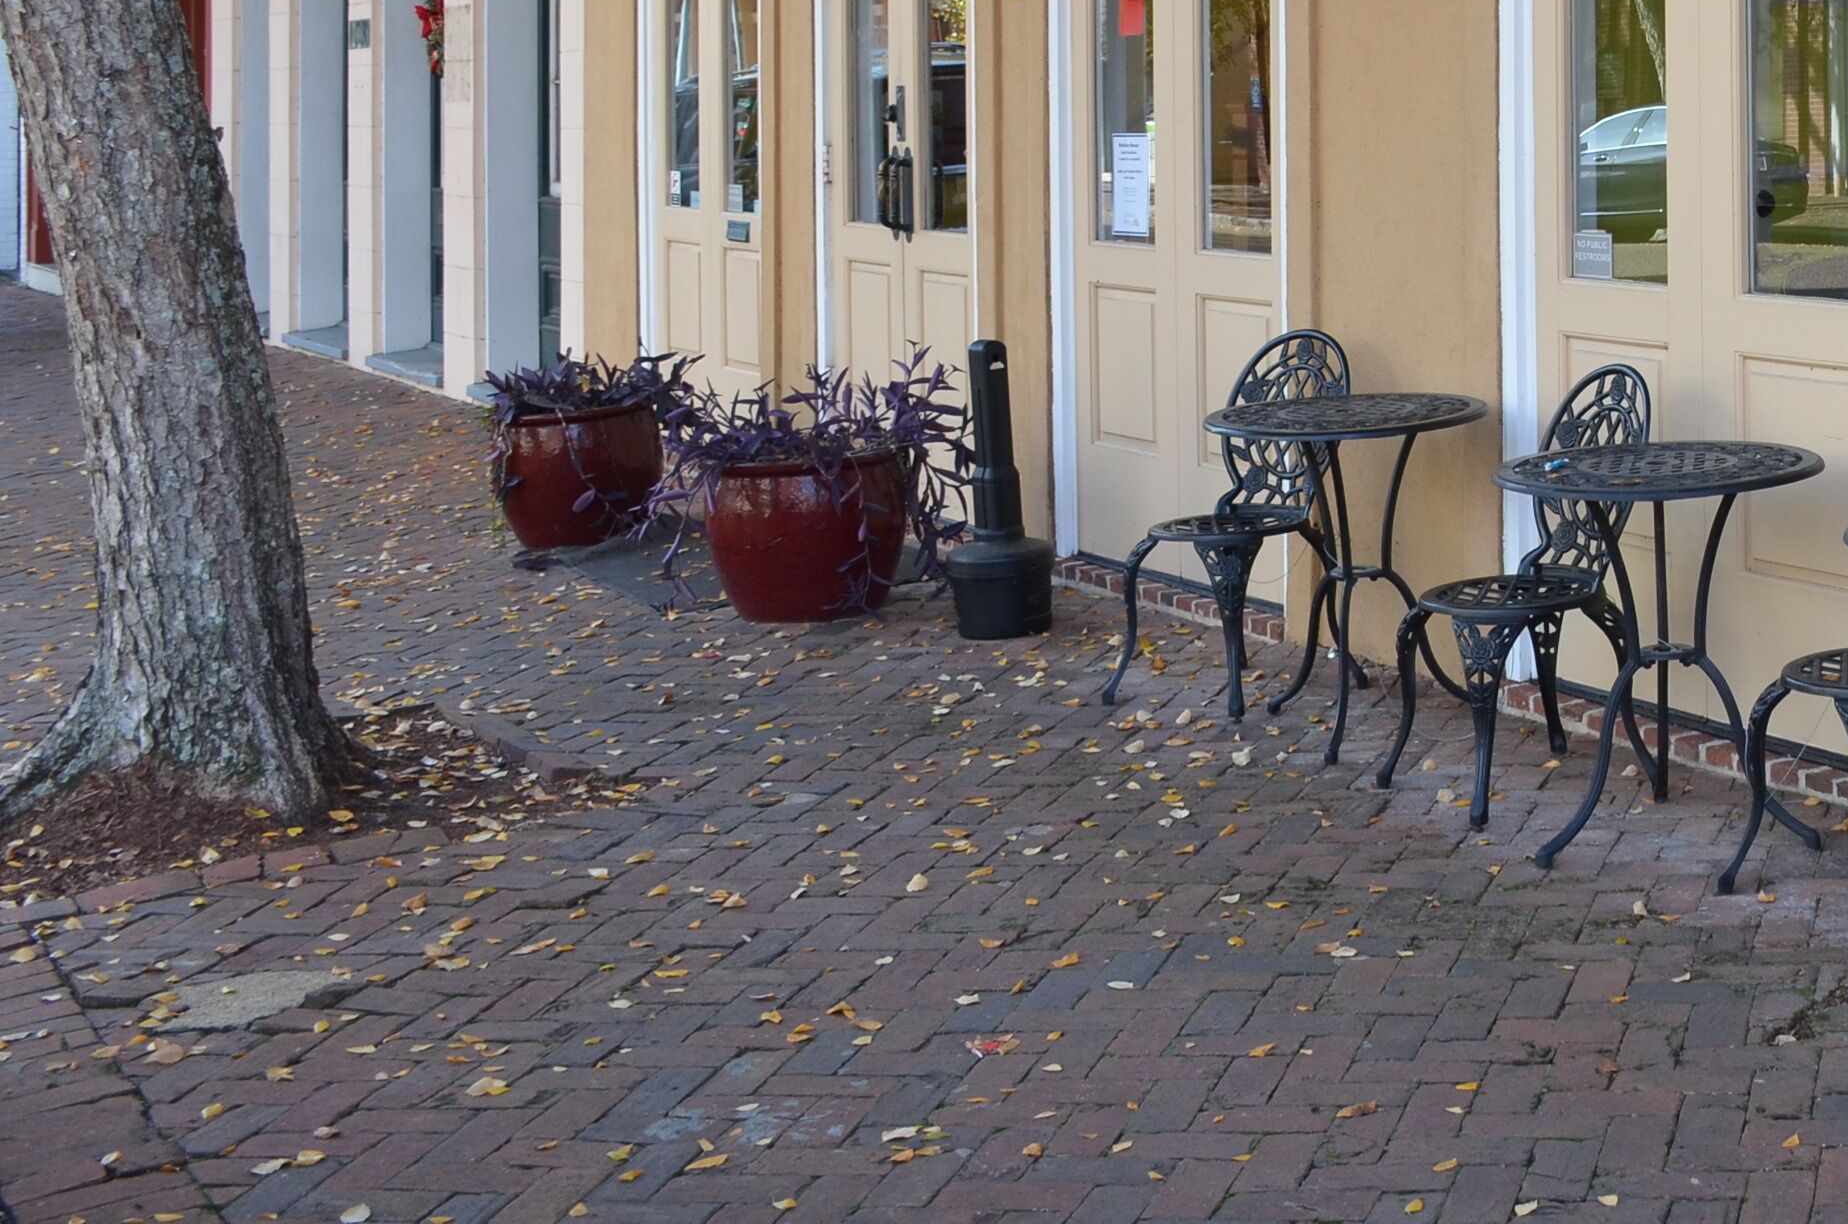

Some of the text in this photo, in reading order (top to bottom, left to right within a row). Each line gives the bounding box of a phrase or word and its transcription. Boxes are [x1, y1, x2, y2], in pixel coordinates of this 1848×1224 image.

[1576, 239, 1609, 251] NO PUBLIC
[1575, 251, 1611, 263] RESTROOMS
